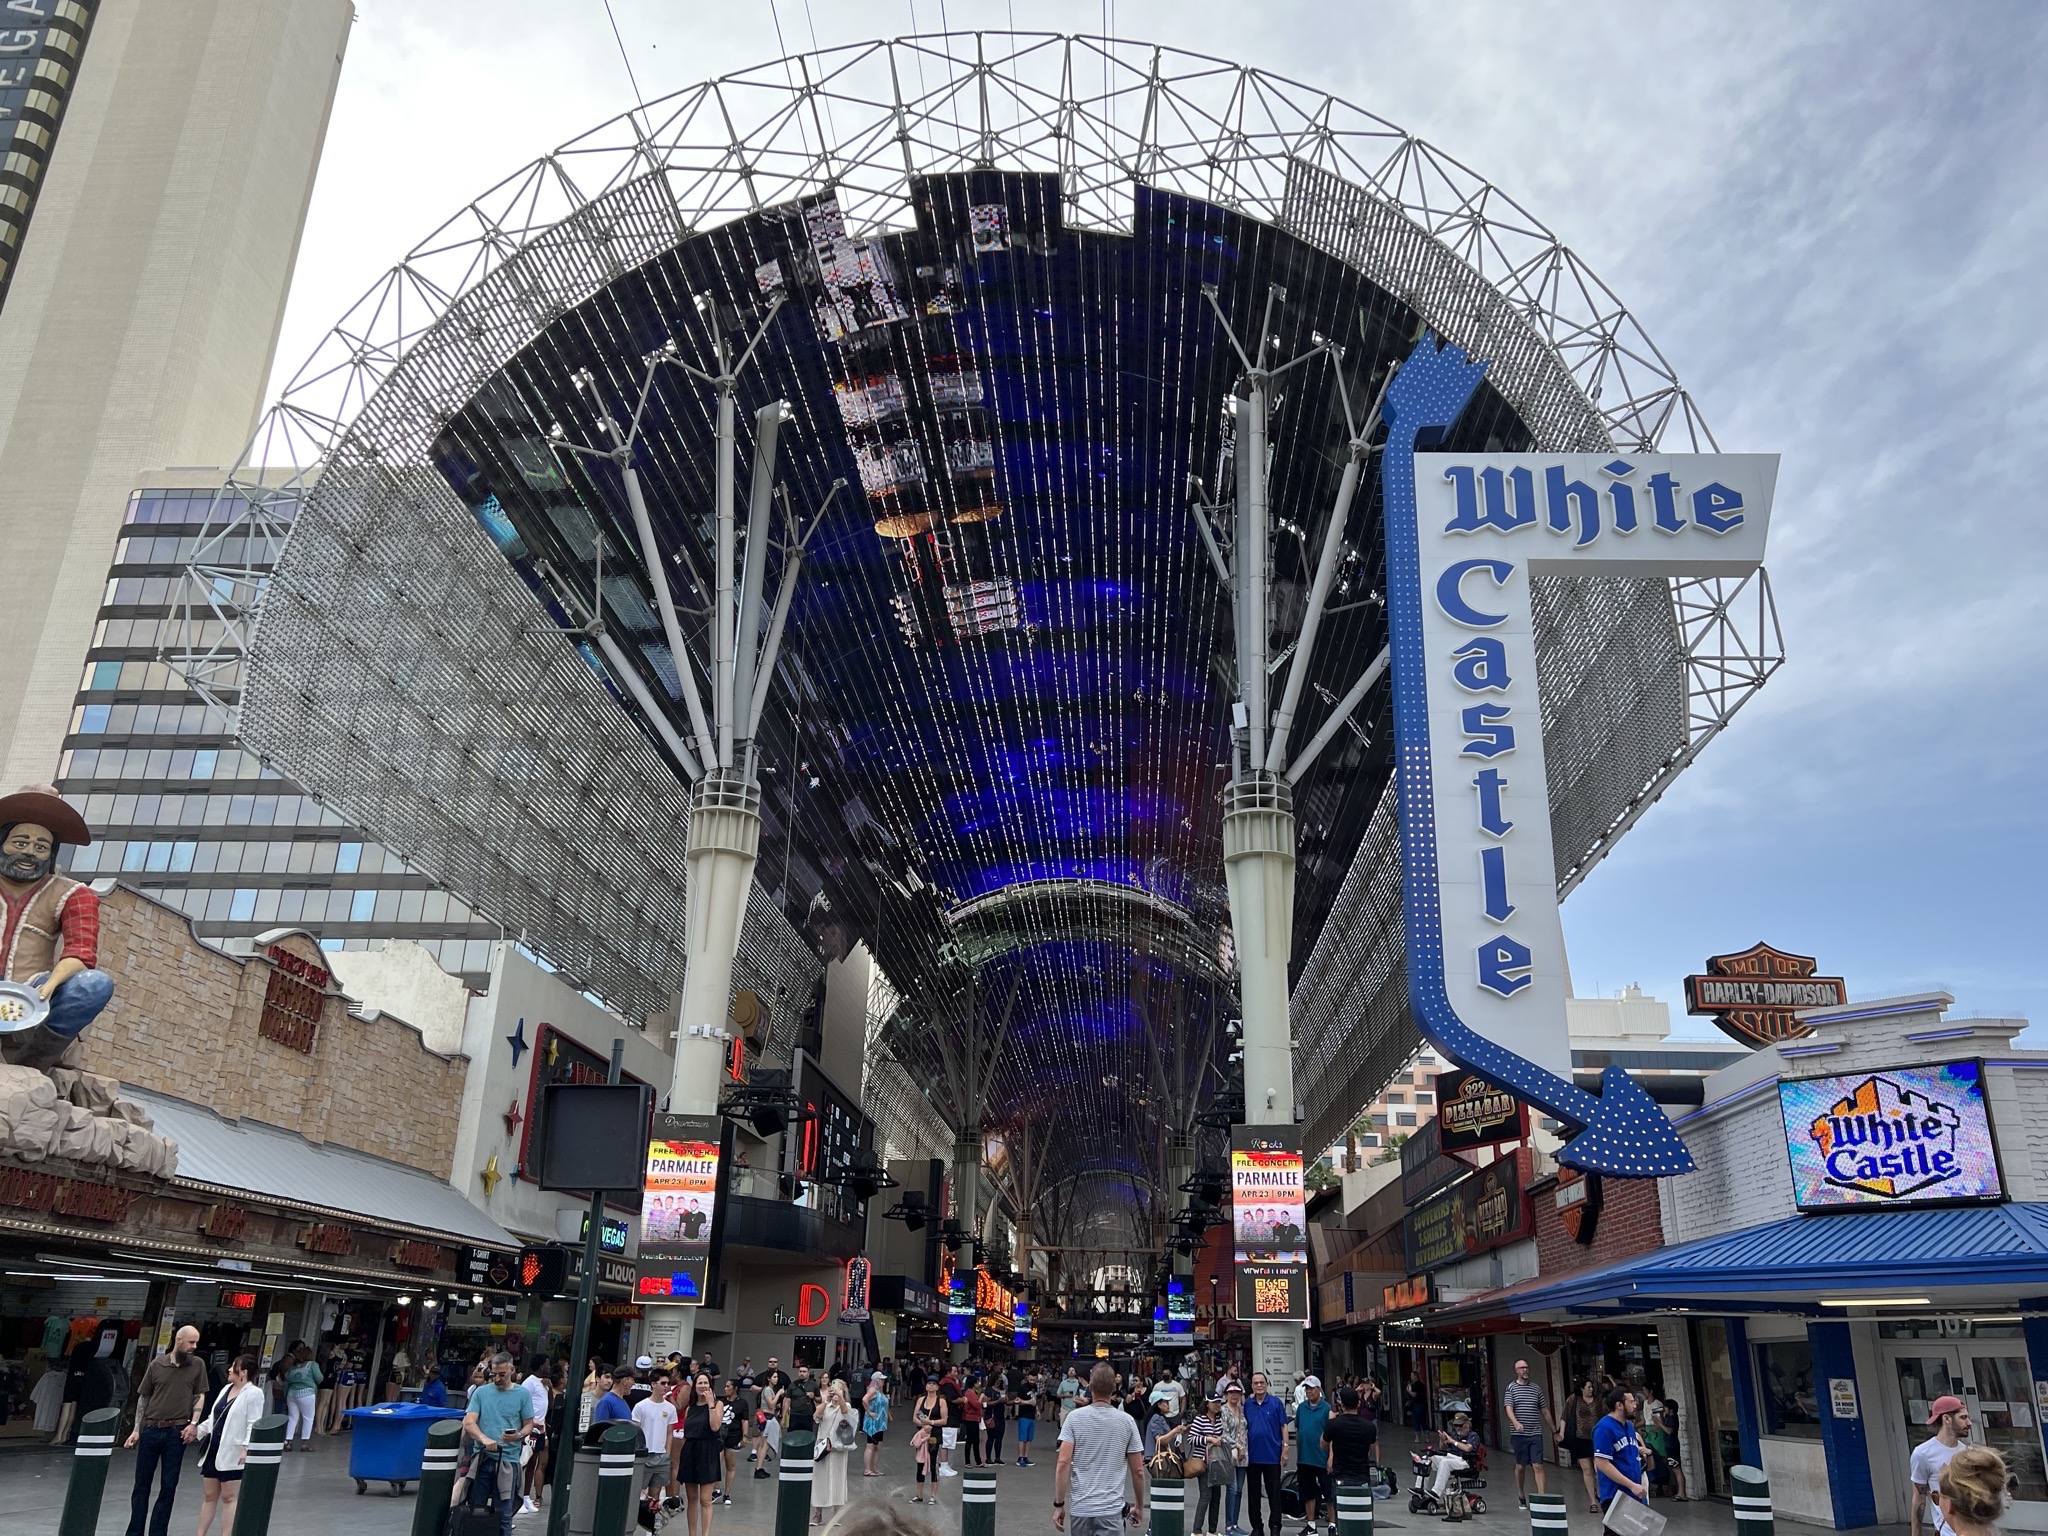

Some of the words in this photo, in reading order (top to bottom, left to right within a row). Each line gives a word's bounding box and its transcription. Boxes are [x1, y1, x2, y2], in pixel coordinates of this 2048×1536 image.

[1443, 458, 1746, 550] White
[1434, 558, 1534, 998] Castle
[1731, 952, 1802, 976] MOTOR
[1703, 981, 1838, 1006] HARLEY-DAVIDSON
[1741, 1010, 1796, 1038] CYCLE
[1464, 1081, 1486, 1099] 322
[1445, 1100, 1483, 1123] PIZZA
[1483, 1094, 1511, 1115] BAR
[1831, 1112, 1943, 1151] White
[675, 1147, 714, 1156] CONCERT
[1826, 1143, 1955, 1181] Castle
[651, 1159, 713, 1174] PARMALEE
[1237, 1171, 1299, 1186] PARMALEE
[1241, 1190, 1257, 1198] APR
[1259, 1190, 1269, 1198] 23
[1277, 1190, 1295, 1198] 9PM
[1414, 1200, 1450, 1231] SOUVENIRS
[601, 1225, 626, 1248] VEGAS
[1418, 1222, 1447, 1247] T-SHIRTS
[472, 1248, 490, 1260] T-SHIRT
[1415, 1240, 1454, 1266] BEVERAGES
[469, 1260, 489, 1272] HOODIES
[471, 1273, 484, 1283] HATS
[605, 1262, 636, 1283] LIQUO
[600, 1304, 638, 1316] LIQUOR
[773, 1304, 796, 1327] the
[798, 1283, 830, 1327] D
[1195, 1303, 1235, 1318] ASIN
[1935, 1311, 1975, 1336] 107
